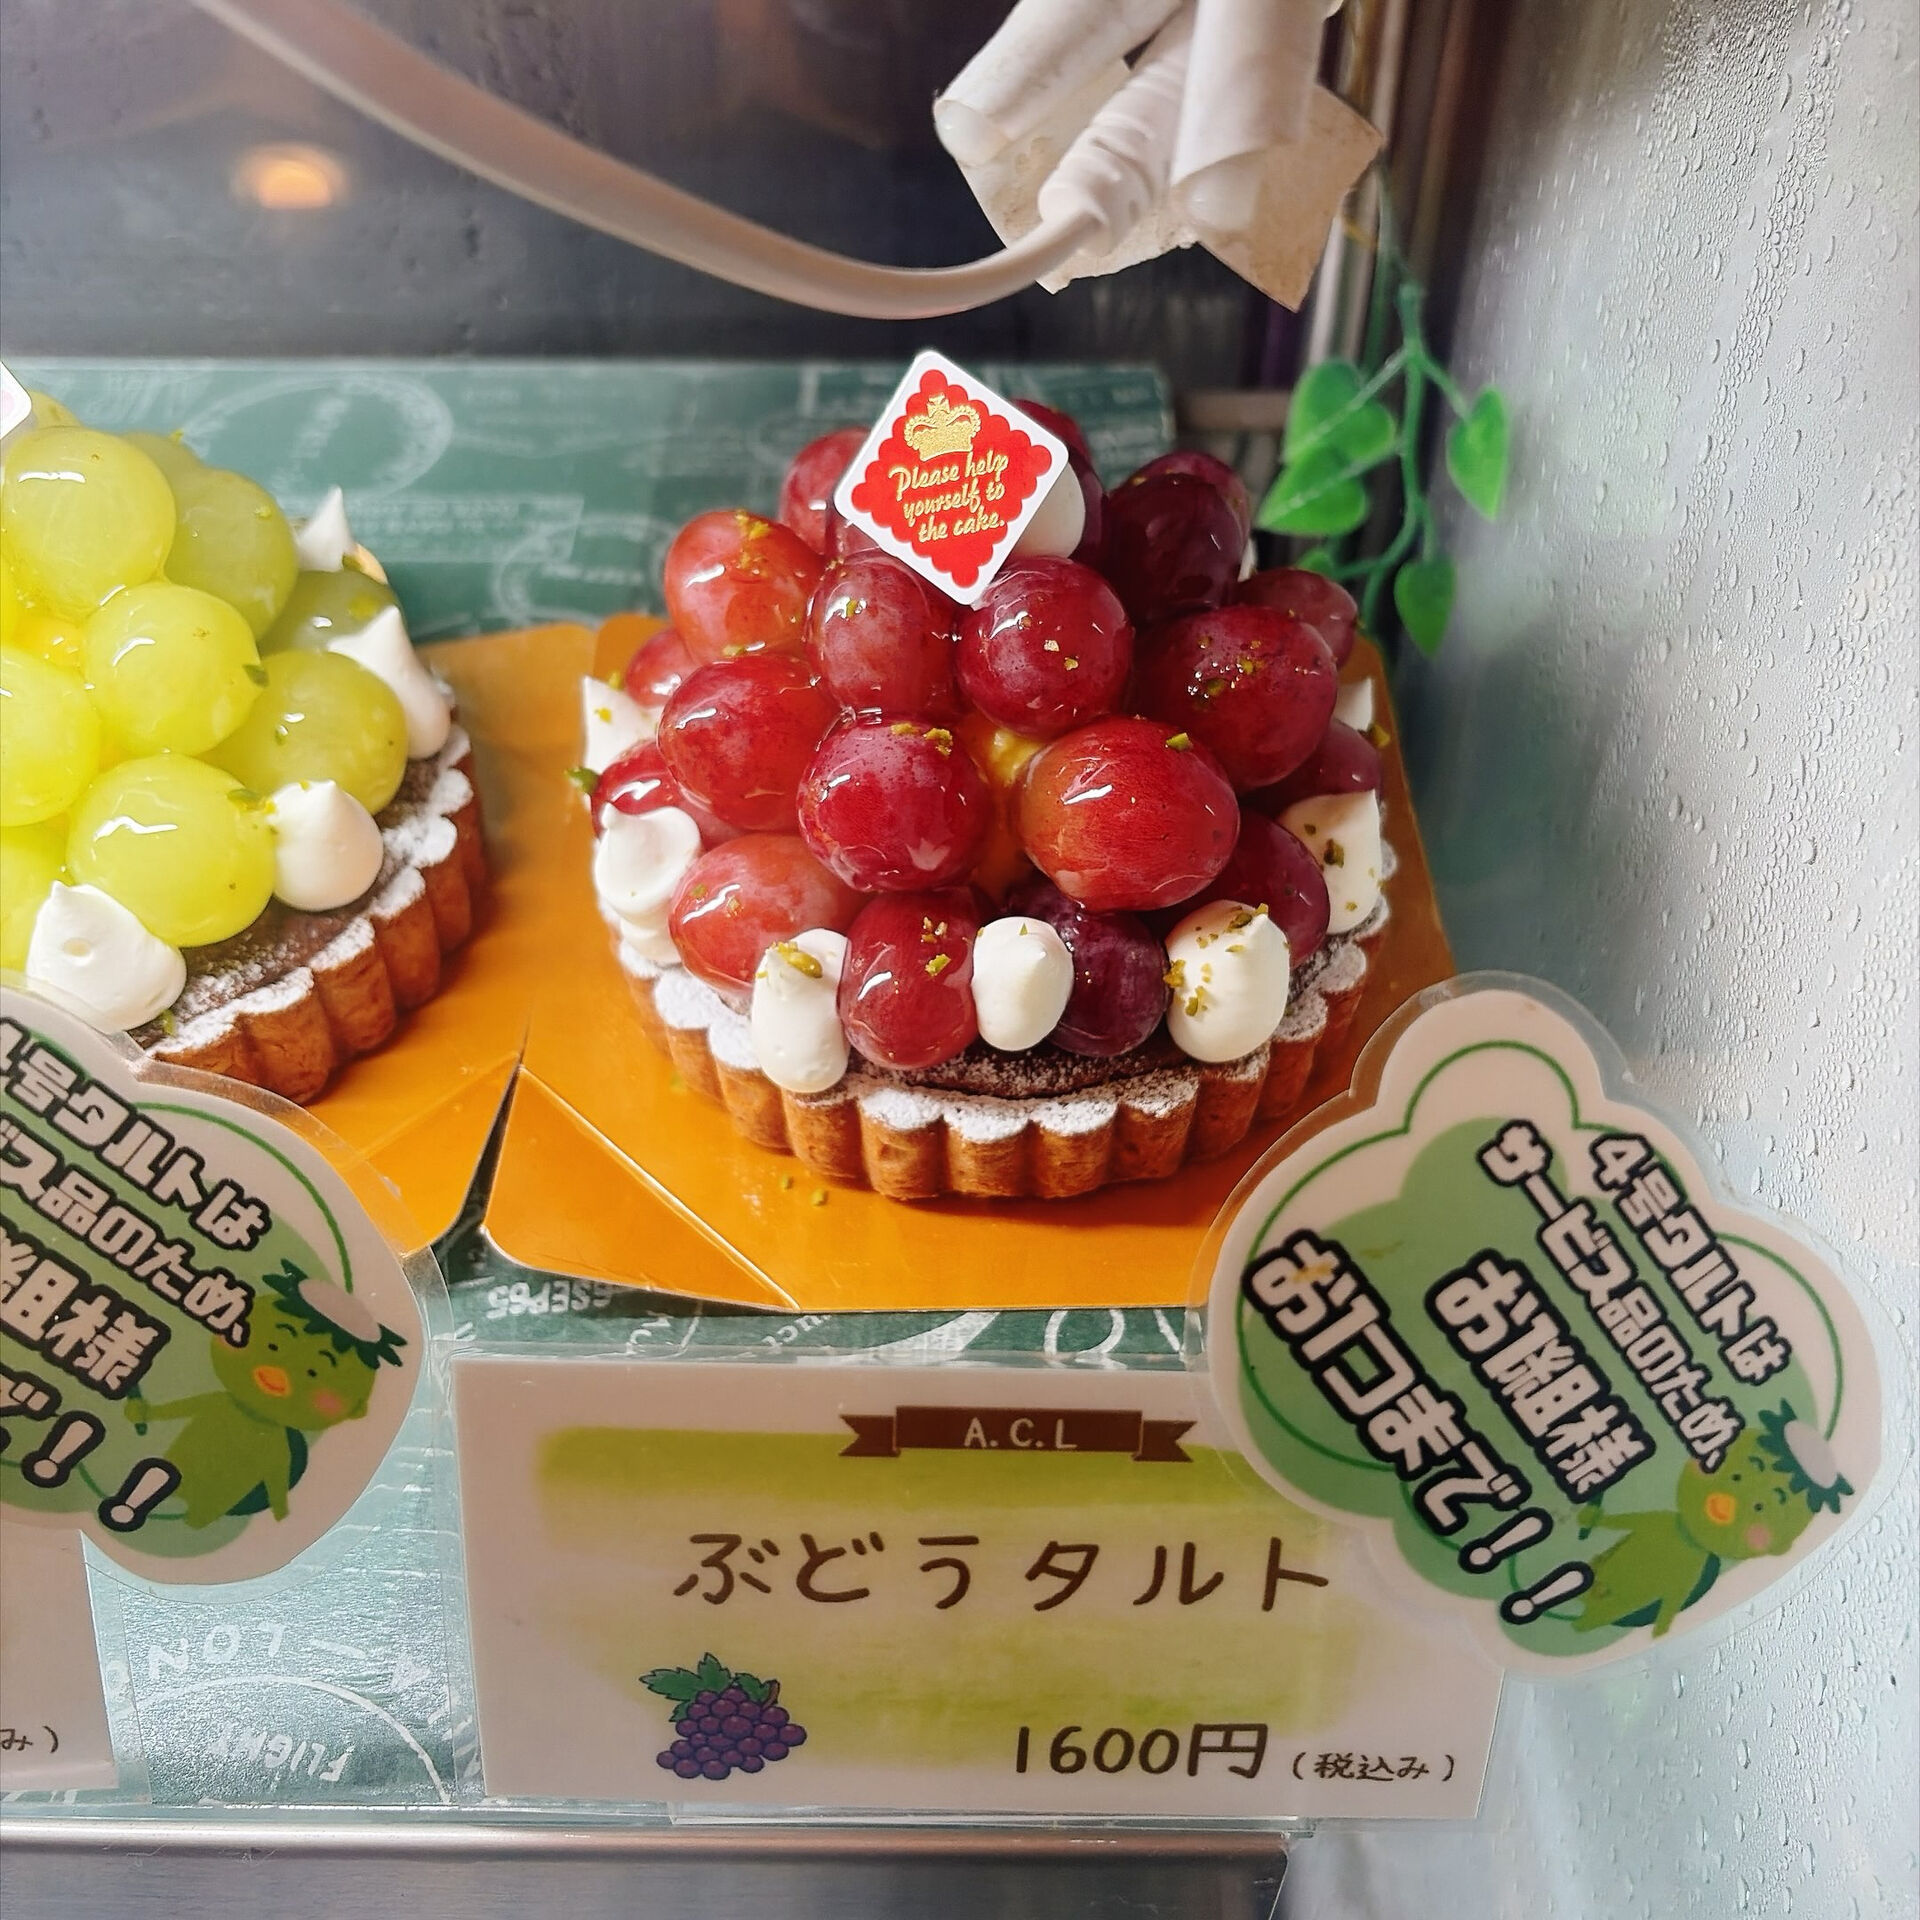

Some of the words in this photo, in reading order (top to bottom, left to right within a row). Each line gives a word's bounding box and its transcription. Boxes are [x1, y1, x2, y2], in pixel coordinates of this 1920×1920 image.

[888, 466, 959, 501] Please
[965, 450, 1008, 482] help
[903, 478, 981, 527] yourself
[986, 481, 1005, 501] to
[918, 516, 948, 543] the
[953, 505, 1005, 536] cake.
[1591, 1130, 1793, 1386] 4号タルトは
[1476, 1119, 1747, 1473] サービス品のため、
[673, 1531, 1329, 1612] ぶどうタルト
[1016, 1723, 1268, 1779] 1600円
[1292, 1751, 1455, 1781] （税込み）
